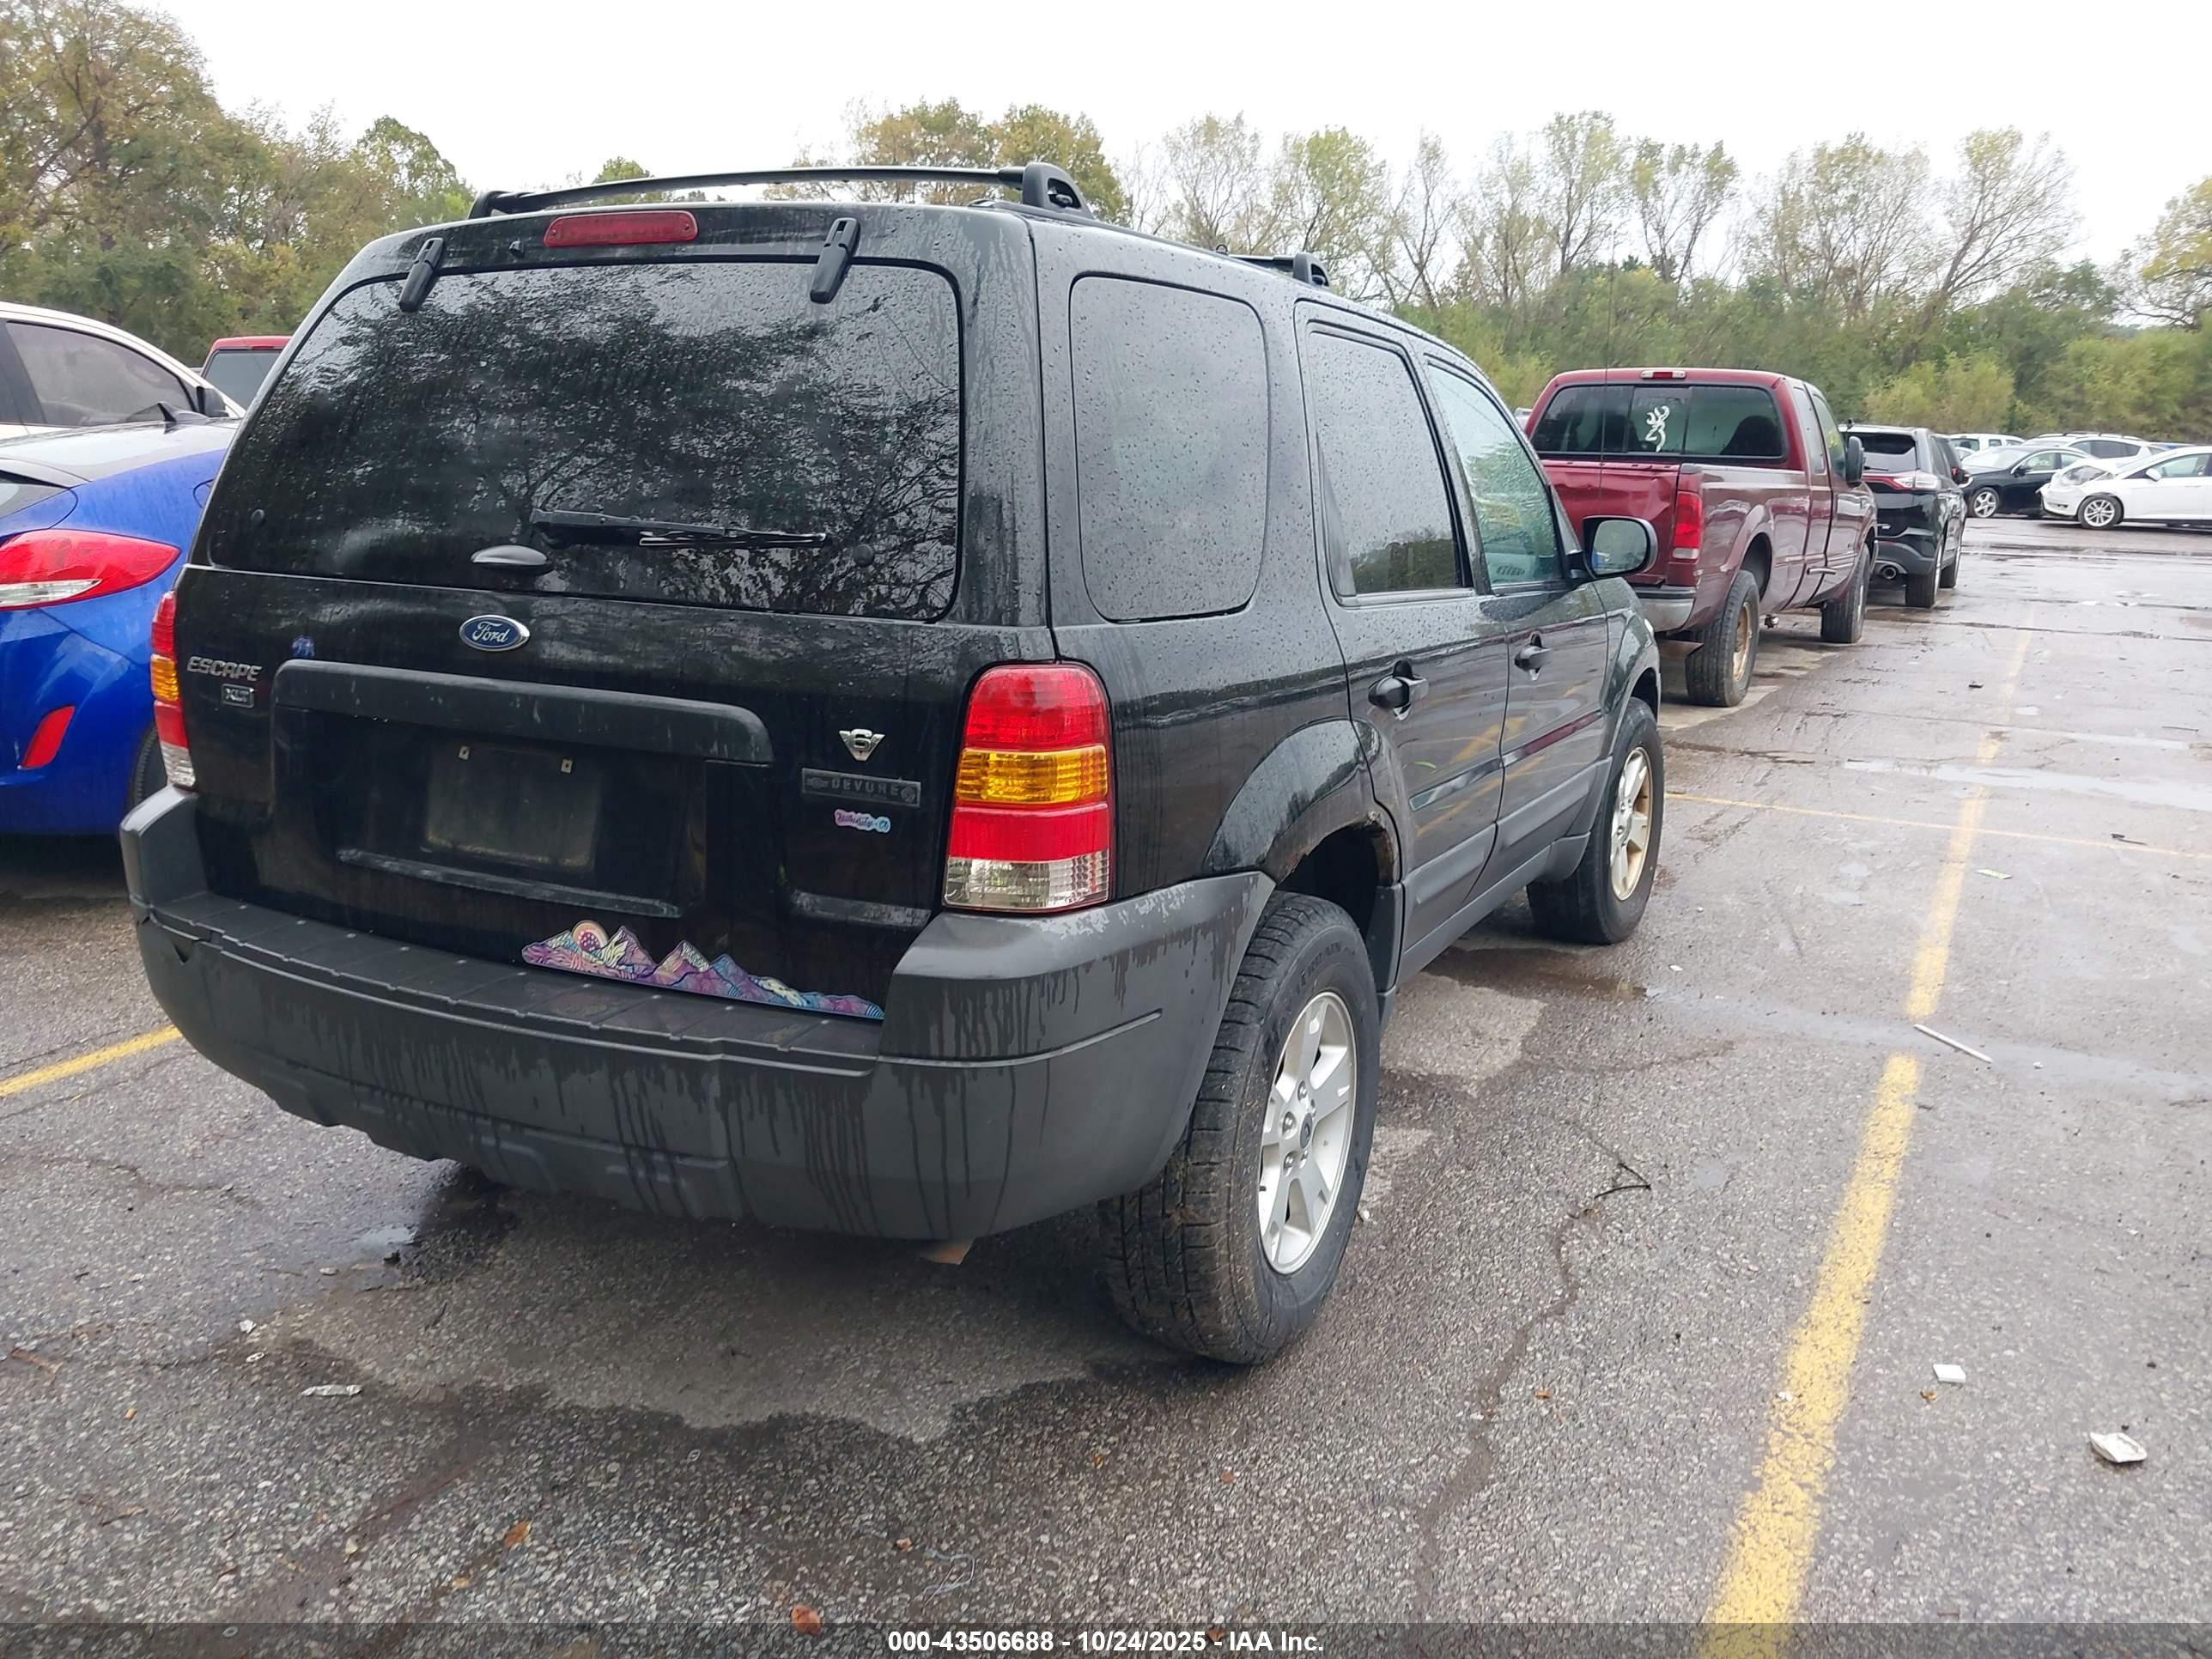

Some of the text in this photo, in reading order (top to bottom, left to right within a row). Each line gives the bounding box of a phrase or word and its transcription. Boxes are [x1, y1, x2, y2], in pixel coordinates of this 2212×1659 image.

[471, 621, 511, 642] Ford
[186, 655, 263, 682] ESCAPE
[225, 688, 249, 702] XLT
